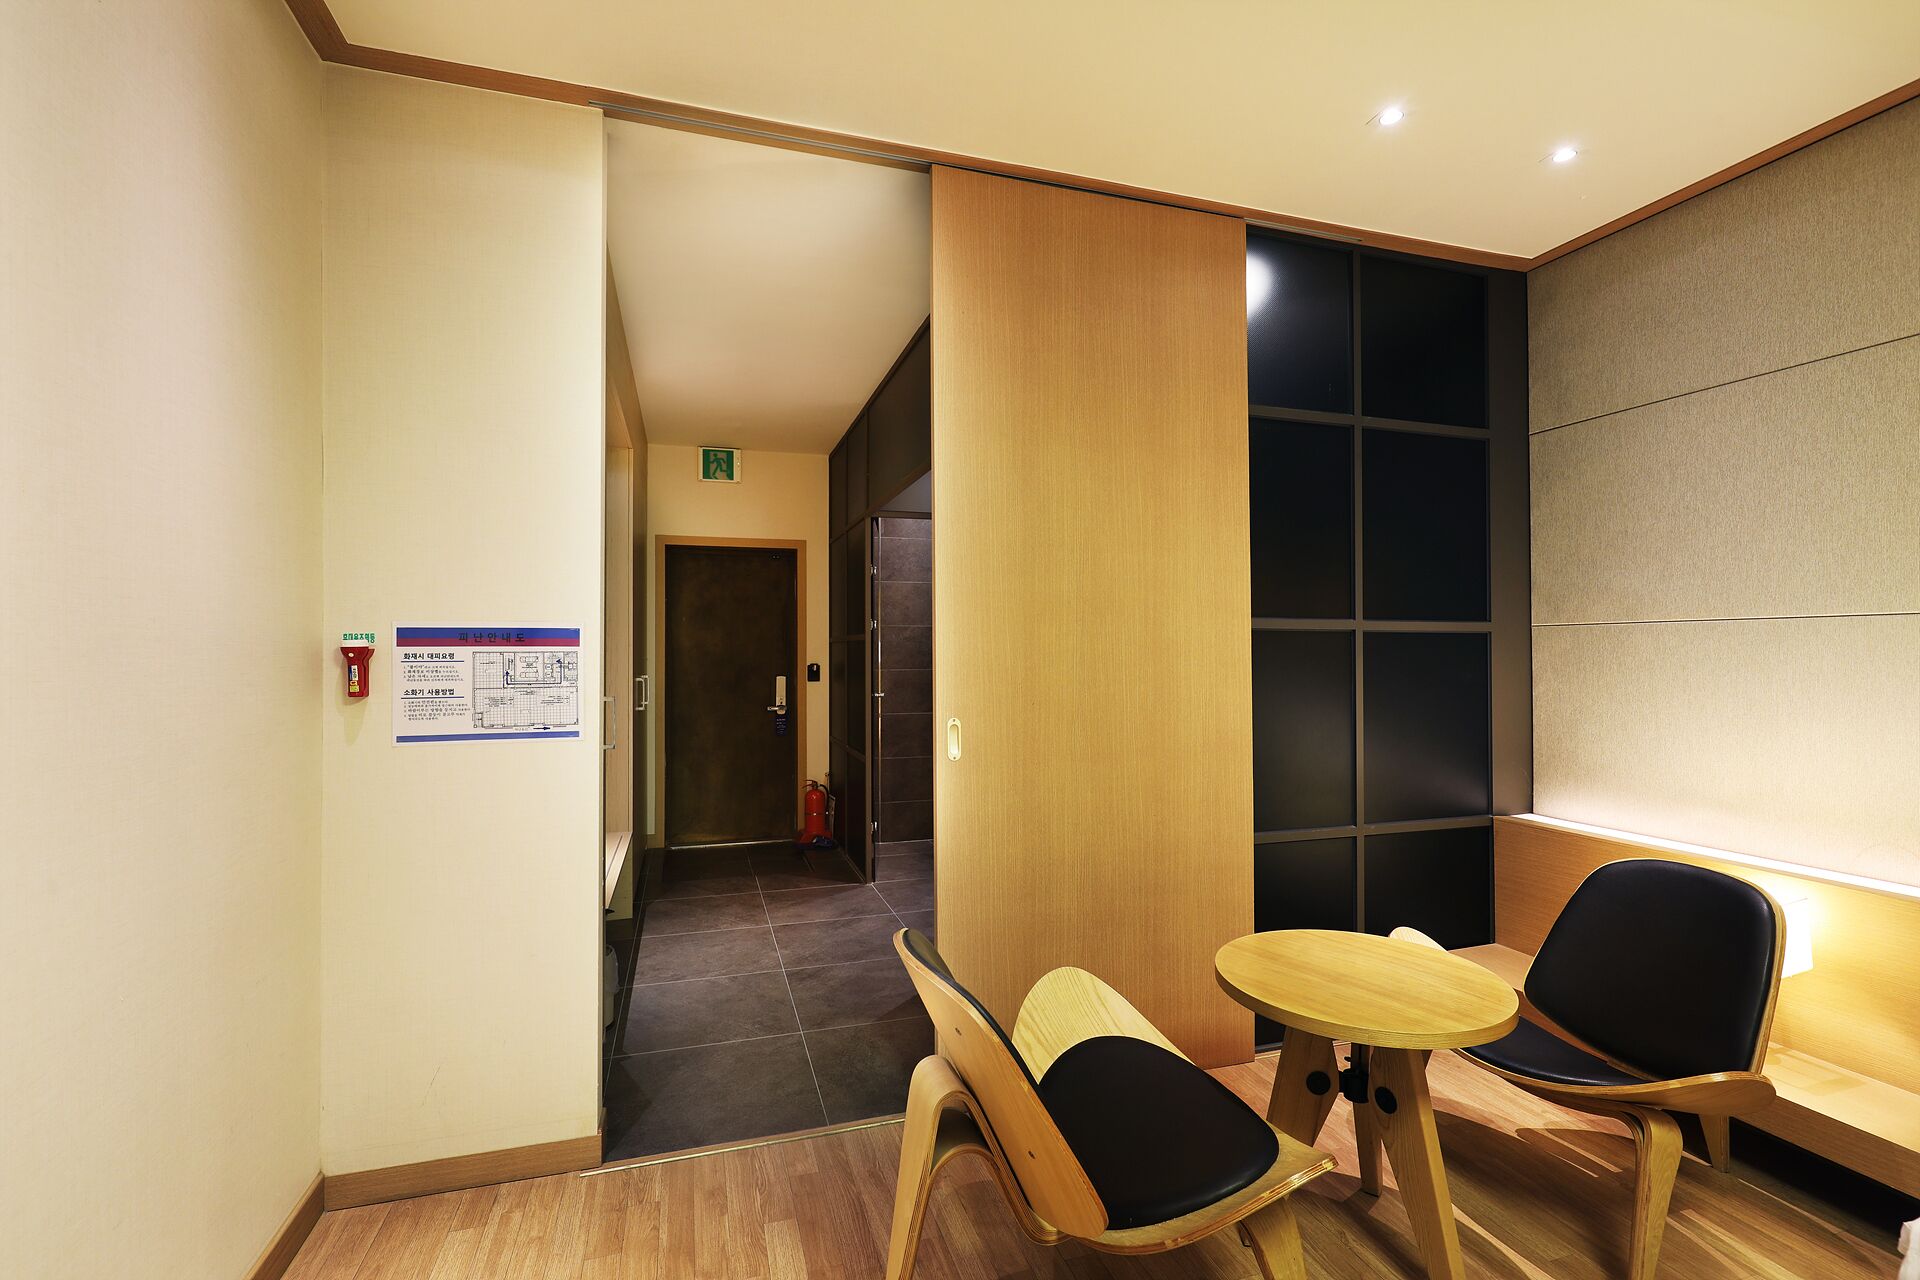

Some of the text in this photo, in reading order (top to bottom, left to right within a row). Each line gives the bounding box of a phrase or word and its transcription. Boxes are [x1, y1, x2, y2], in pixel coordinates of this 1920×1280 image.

[403, 652, 455, 660] 화재시 대피요령
[427, 688, 455, 696] 사용방법
